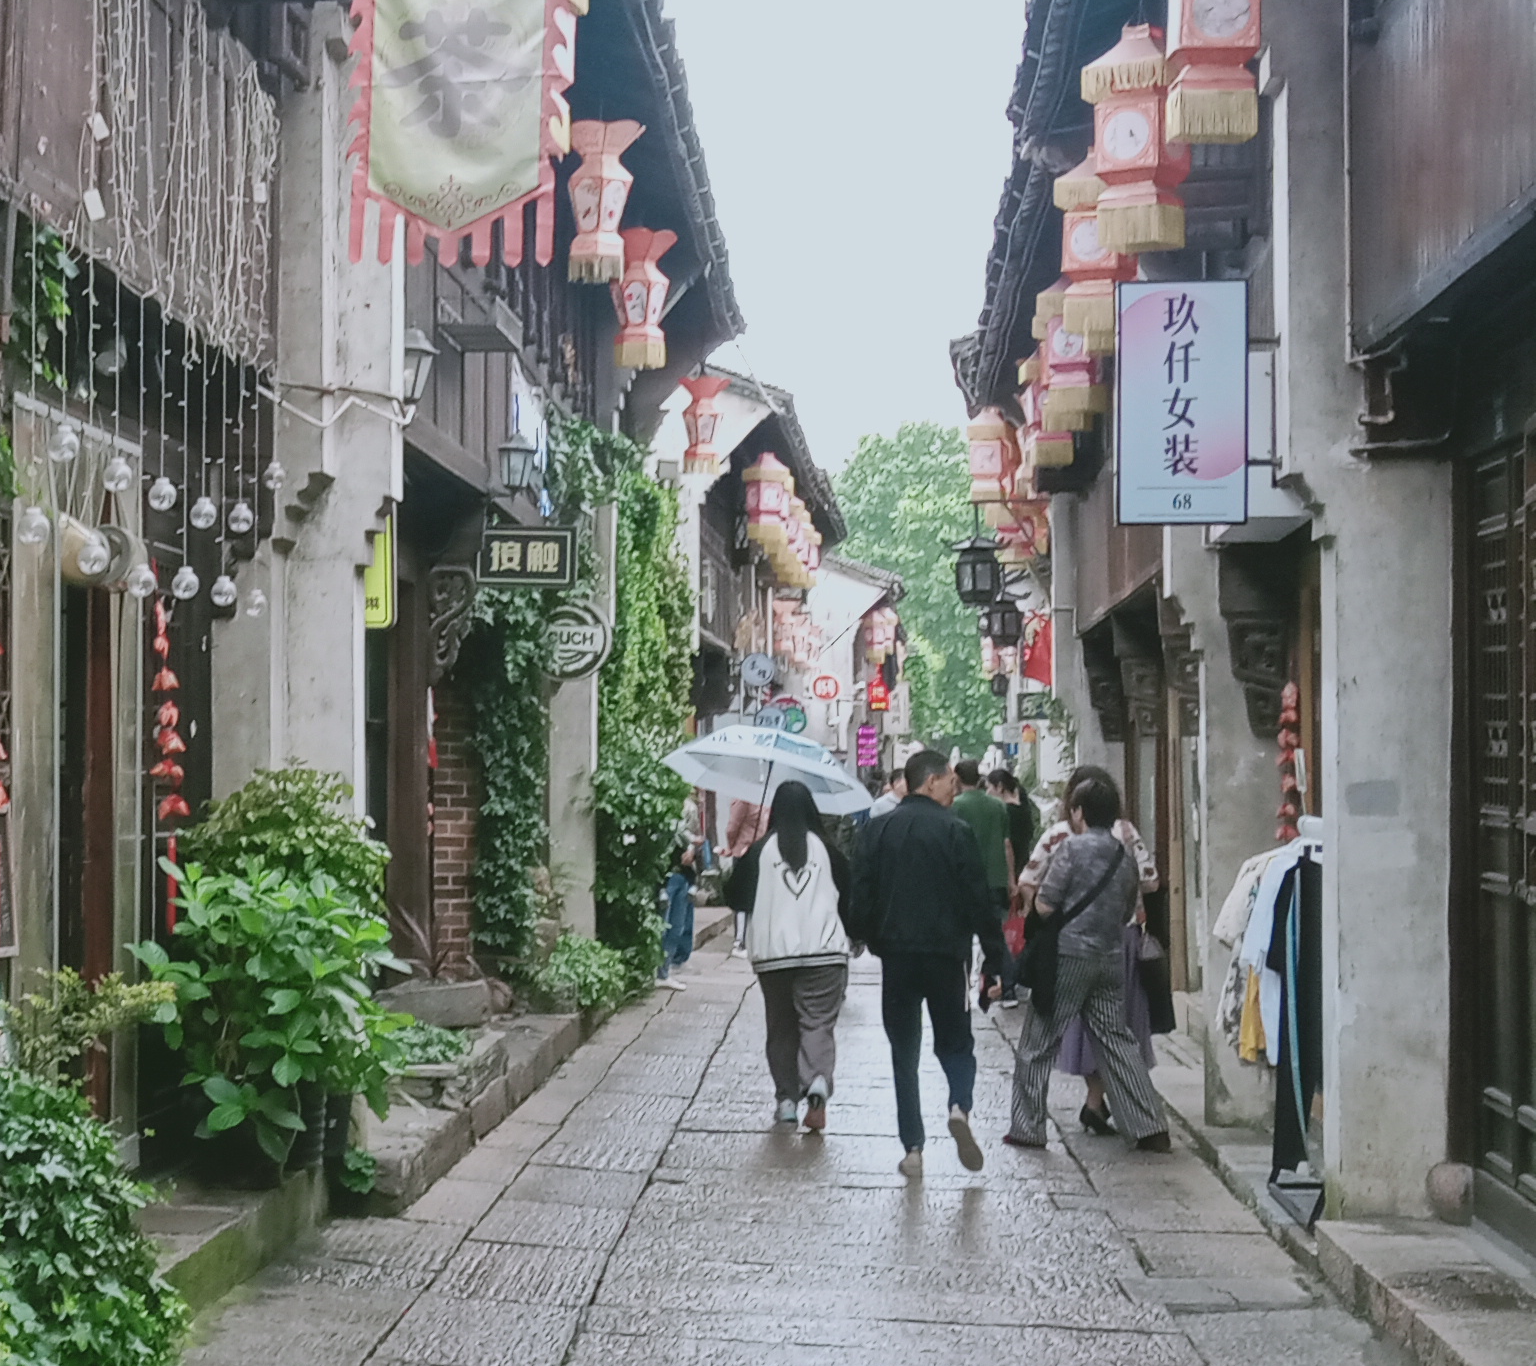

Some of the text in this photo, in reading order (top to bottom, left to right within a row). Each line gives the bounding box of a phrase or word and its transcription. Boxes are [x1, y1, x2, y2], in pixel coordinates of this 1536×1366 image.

[1162, 292, 1201, 478] 玖仟女装
[1172, 493, 1192, 511] 68
[488, 540, 560, 573] 接触
[547, 630, 594, 646] OUCH
